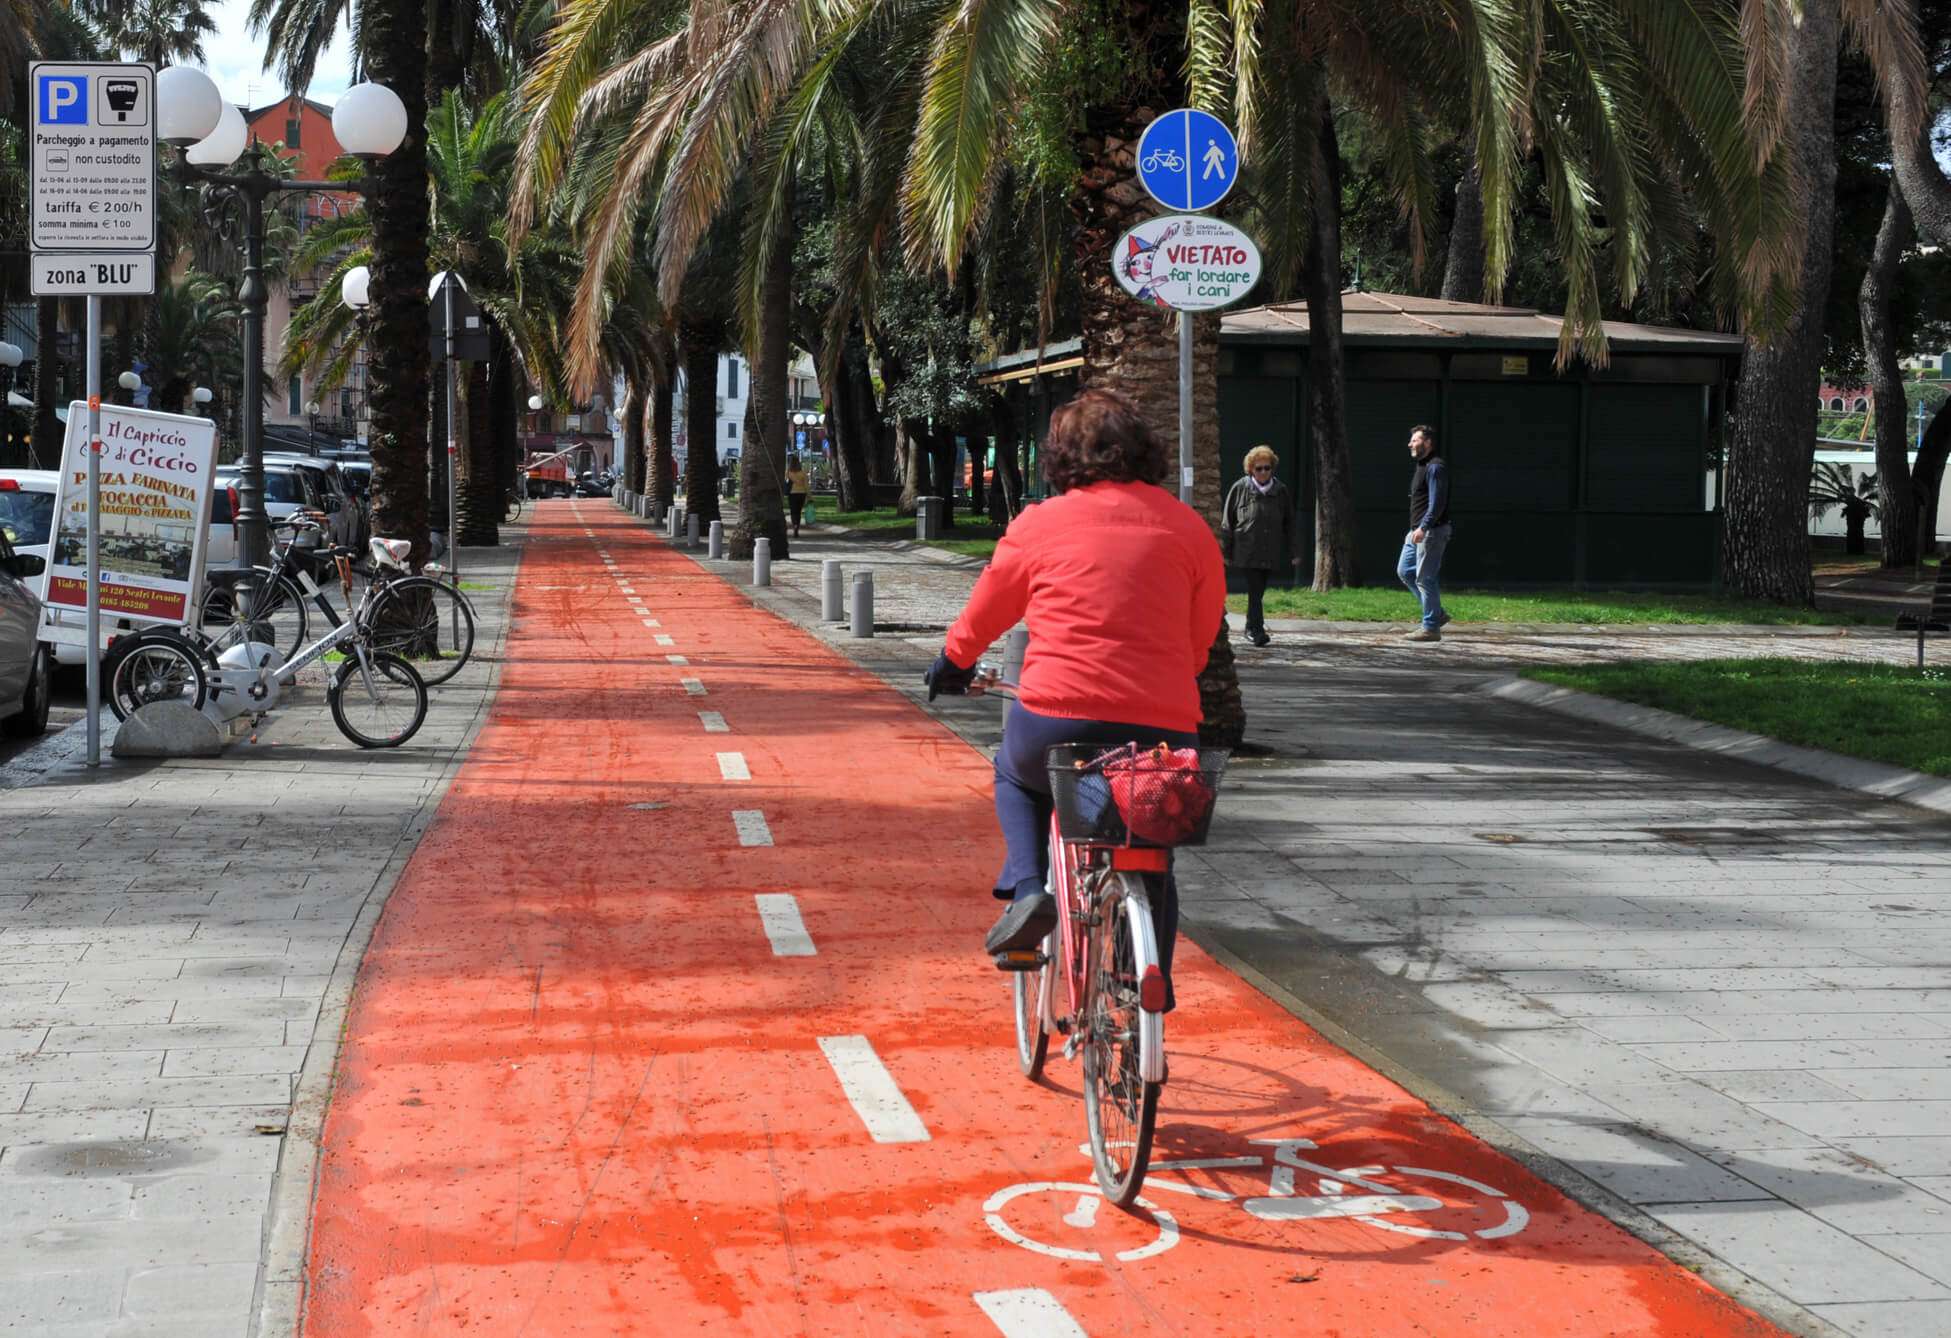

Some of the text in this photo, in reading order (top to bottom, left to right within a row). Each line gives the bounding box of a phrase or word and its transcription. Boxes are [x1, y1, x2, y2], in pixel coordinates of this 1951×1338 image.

[48, 80, 78, 120] P
[36, 133, 149, 148] Parcheggio a pagamento
[75, 153, 141, 165] non custodito
[46, 201, 81, 213] tariffa
[88, 201, 100, 213] €
[69, 219, 98, 228] minima
[102, 220, 111, 228] €
[1167, 244, 1247, 266] VIETATO
[47, 264, 138, 284] zona "BLU"
[1169, 267, 1250, 283] far lordare
[1188, 282, 1230, 297] i cani
[107, 421, 186, 447] Il Capriccio
[115, 446, 198, 473] di Ciccio
[72, 472, 196, 503] PZZA FARINATA
[99, 490, 169, 507] FOCACCIA
[81, 503, 142, 517] FMAGGIO
